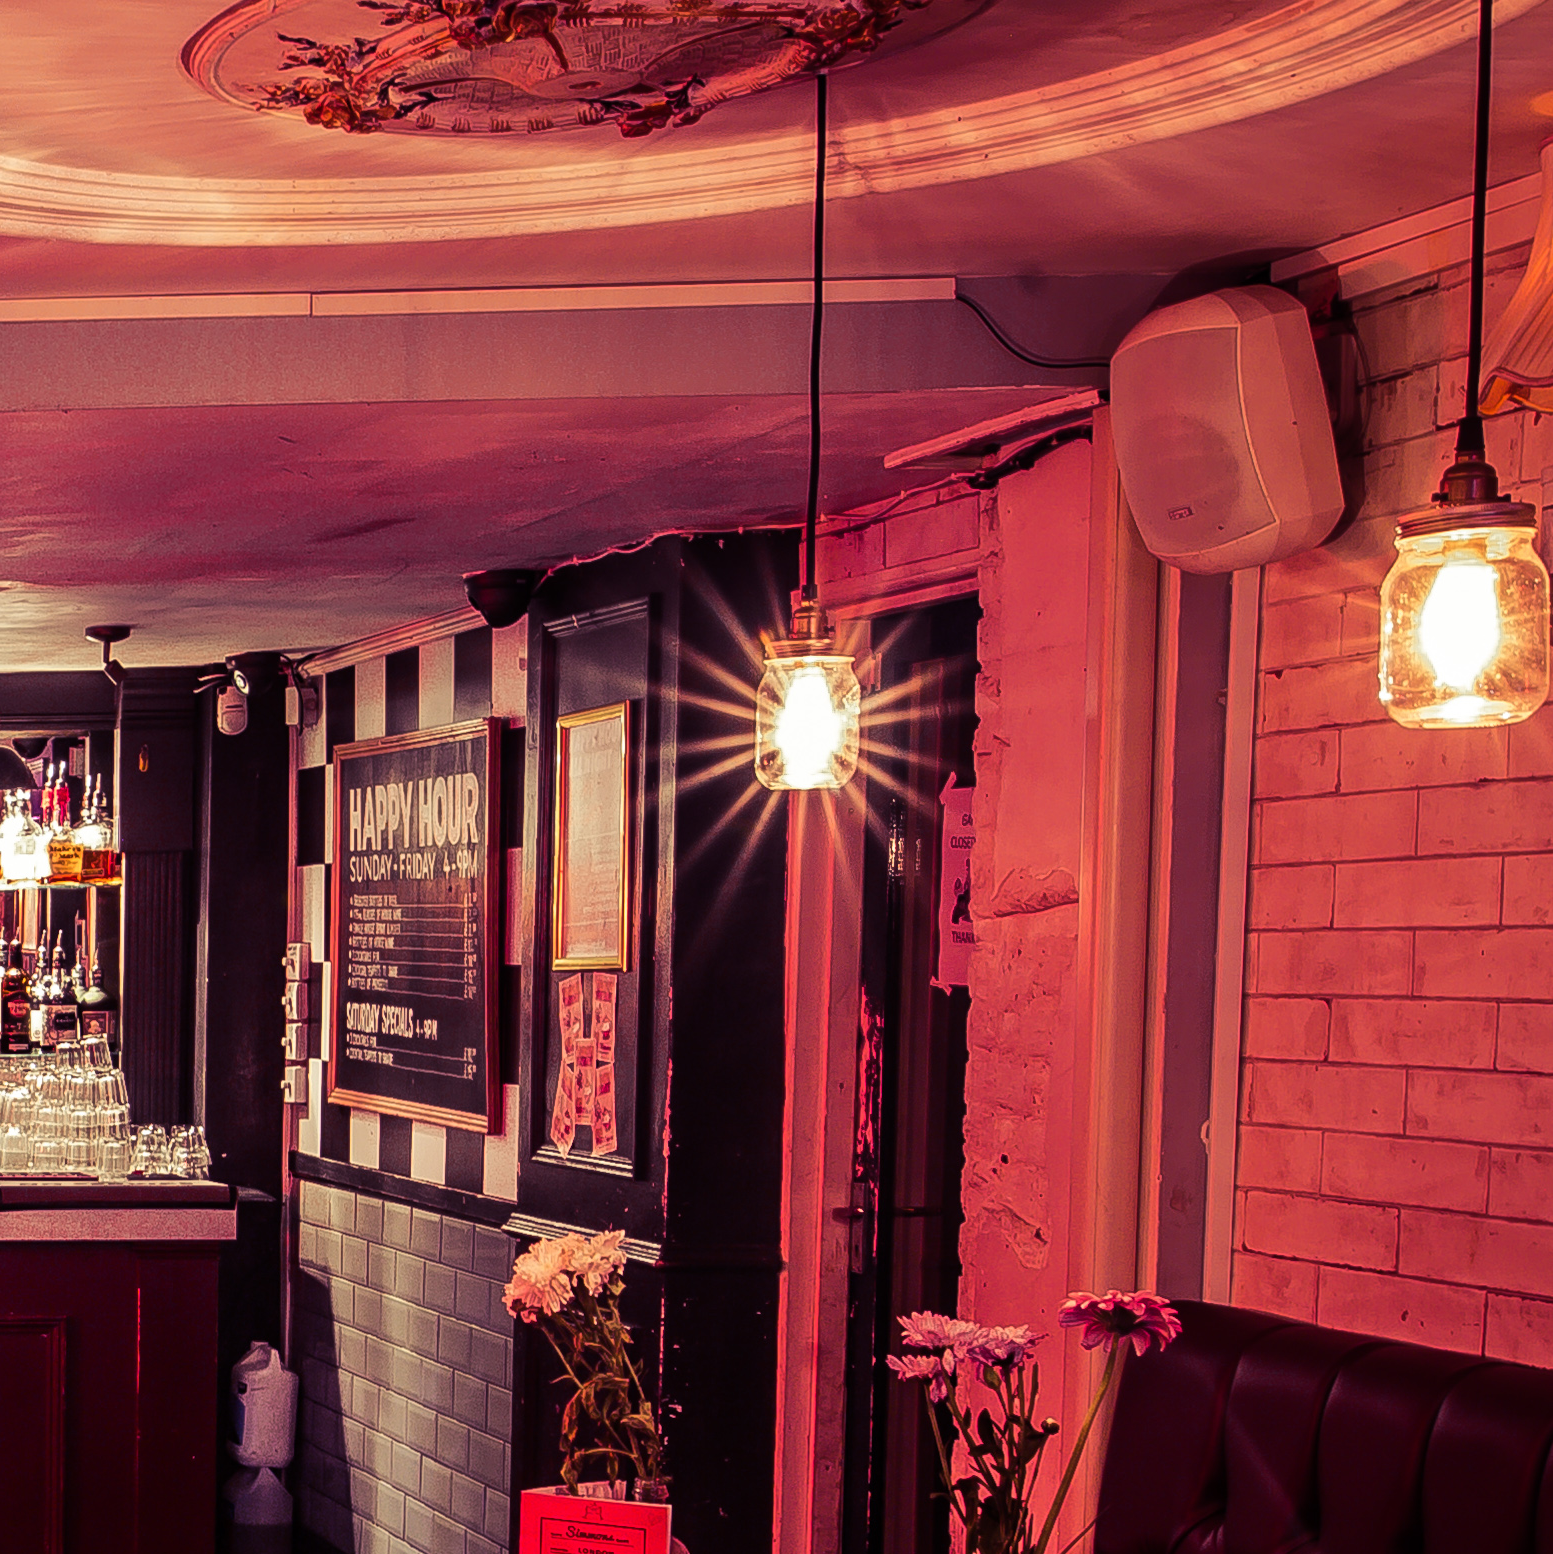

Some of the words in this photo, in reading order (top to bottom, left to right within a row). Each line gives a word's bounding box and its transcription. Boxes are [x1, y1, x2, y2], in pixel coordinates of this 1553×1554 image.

[350, 781, 413, 852] HAPPY
[418, 772, 479, 848] HOUR
[346, 1001, 380, 1033] SATURDAY
[381, 1004, 413, 1038] SPECIALS
